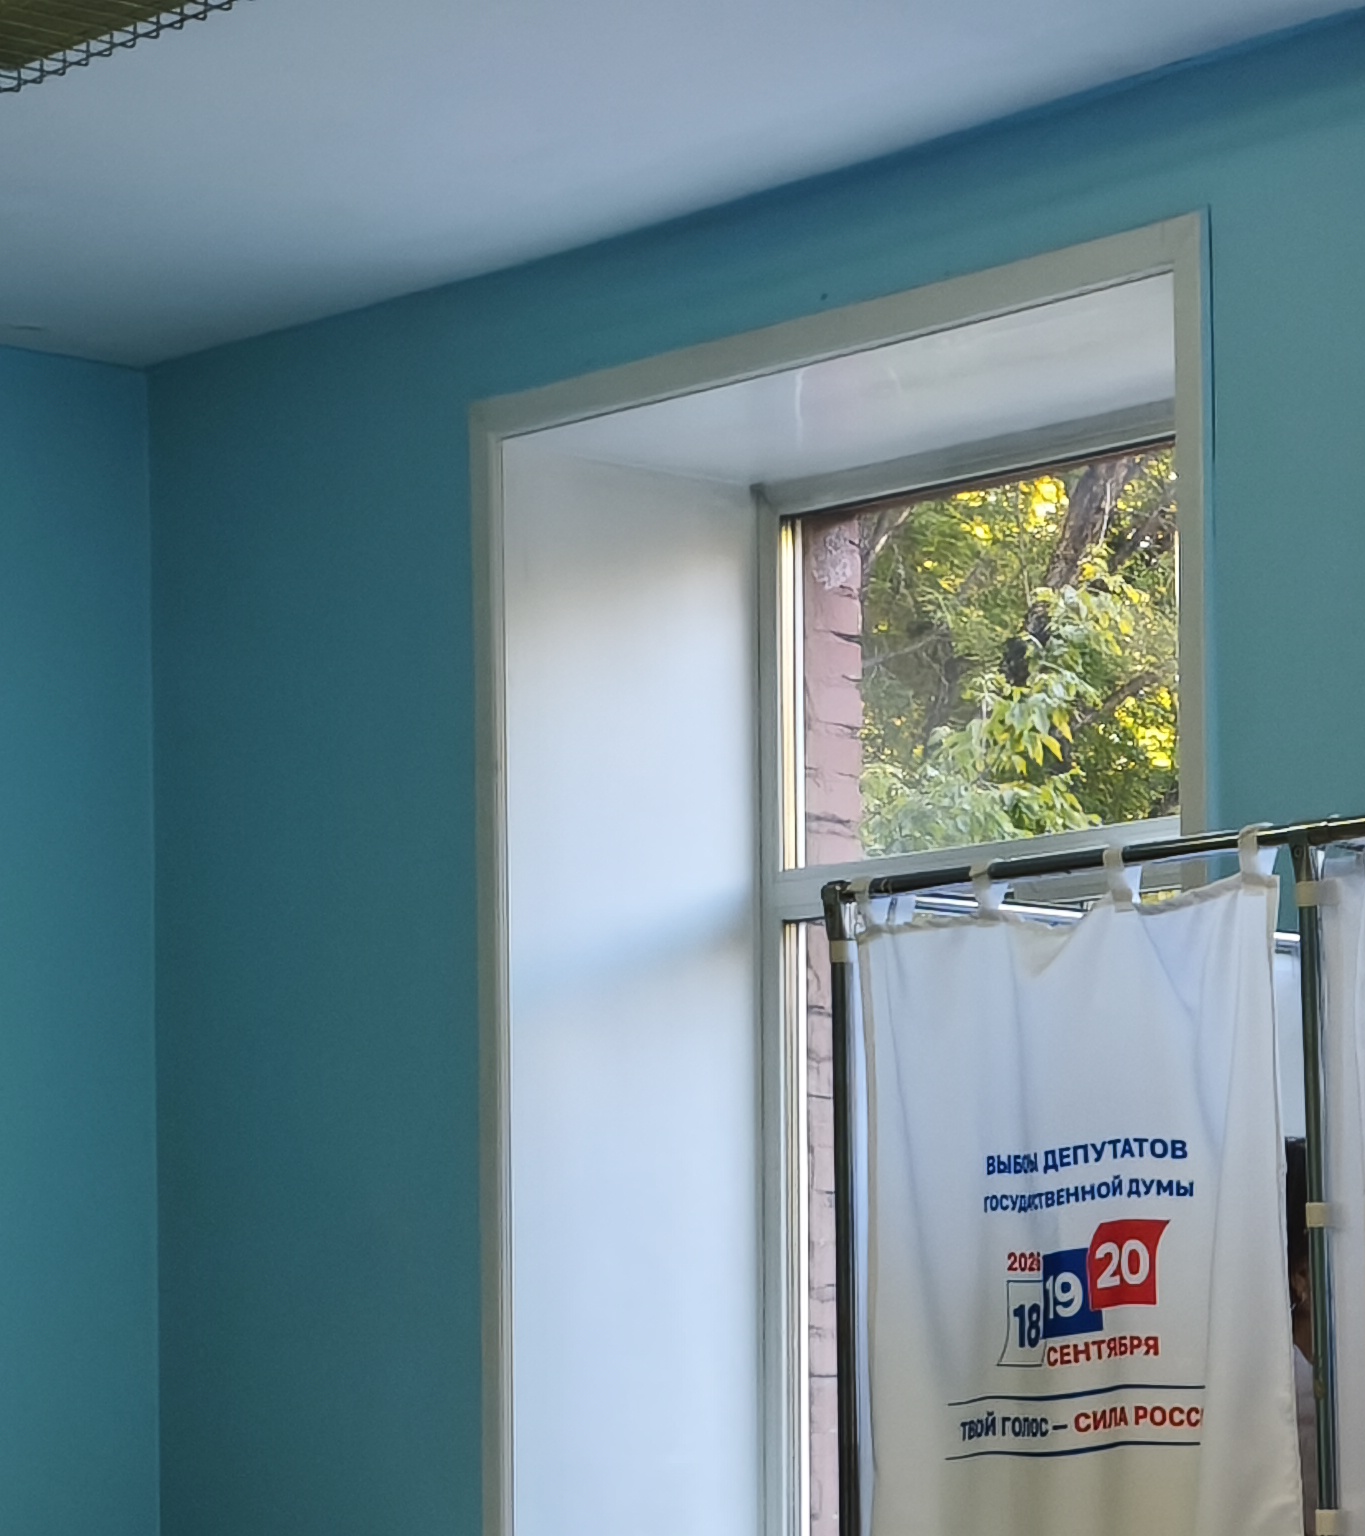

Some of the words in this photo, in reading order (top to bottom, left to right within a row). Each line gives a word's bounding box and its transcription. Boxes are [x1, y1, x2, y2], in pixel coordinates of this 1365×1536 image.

[1043, 1137, 1188, 1174] ДЕПУТАТОВ
[1127, 1178, 1195, 1199] ДУМЫ
[1095, 1239, 1150, 1289] 20
[1046, 1271, 1083, 1319] 19
[1013, 1303, 1041, 1349] 18
[1047, 1335, 1160, 1367] СЕНТЯБРЯ
[960, 1411, 997, 1442] ТВОЙ
[1001, 1416, 1049, 1438] ГОЛОС
[1074, 1406, 1128, 1433] СИЛА
